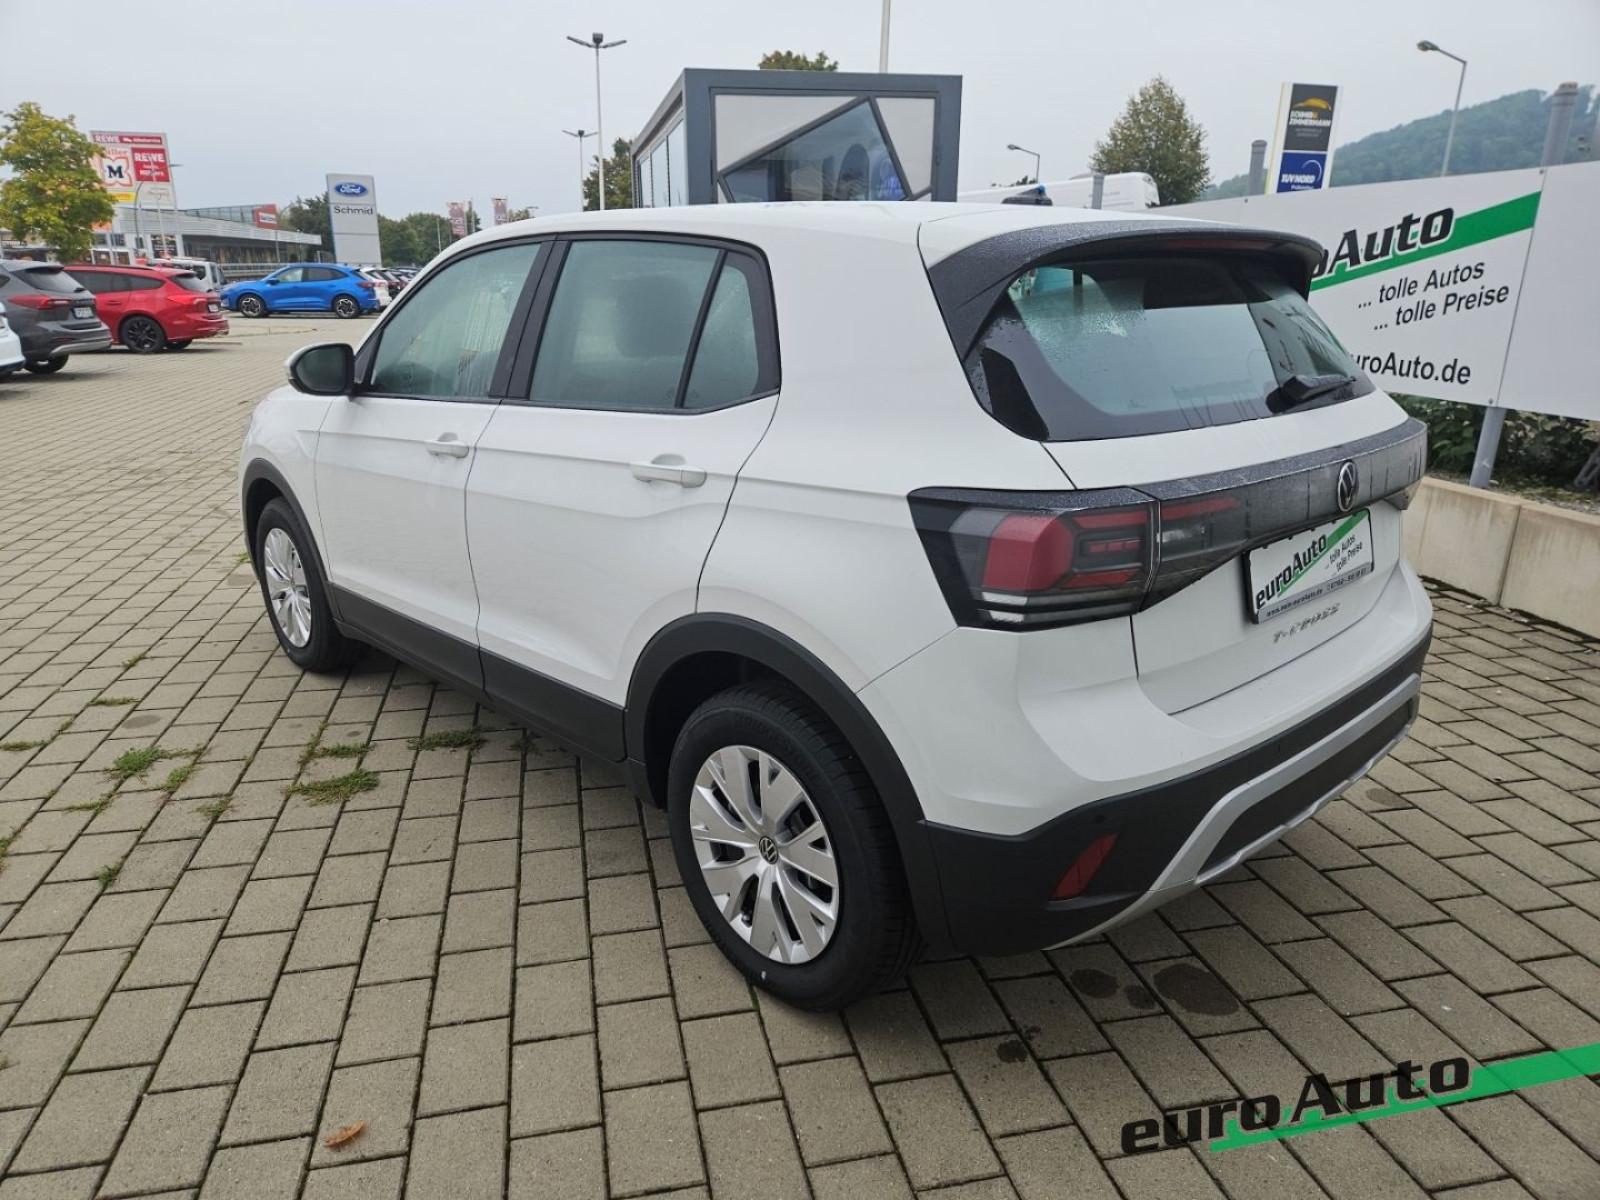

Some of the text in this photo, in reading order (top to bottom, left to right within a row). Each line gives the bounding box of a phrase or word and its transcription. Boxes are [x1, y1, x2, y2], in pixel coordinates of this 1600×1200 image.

[134, 152, 165, 162] REWE
[107, 164, 124, 178] M
[1295, 174, 1316, 184] NORD
[340, 183, 361, 194] Ford
[334, 206, 373, 215] Schmid
[1379, 277, 1418, 303] tolle
[1424, 262, 1485, 292] Autos
[1396, 300, 1436, 326] tolle
[1442, 285, 1509, 316] Preise
[1256, 533, 1327, 609] euroAuto
